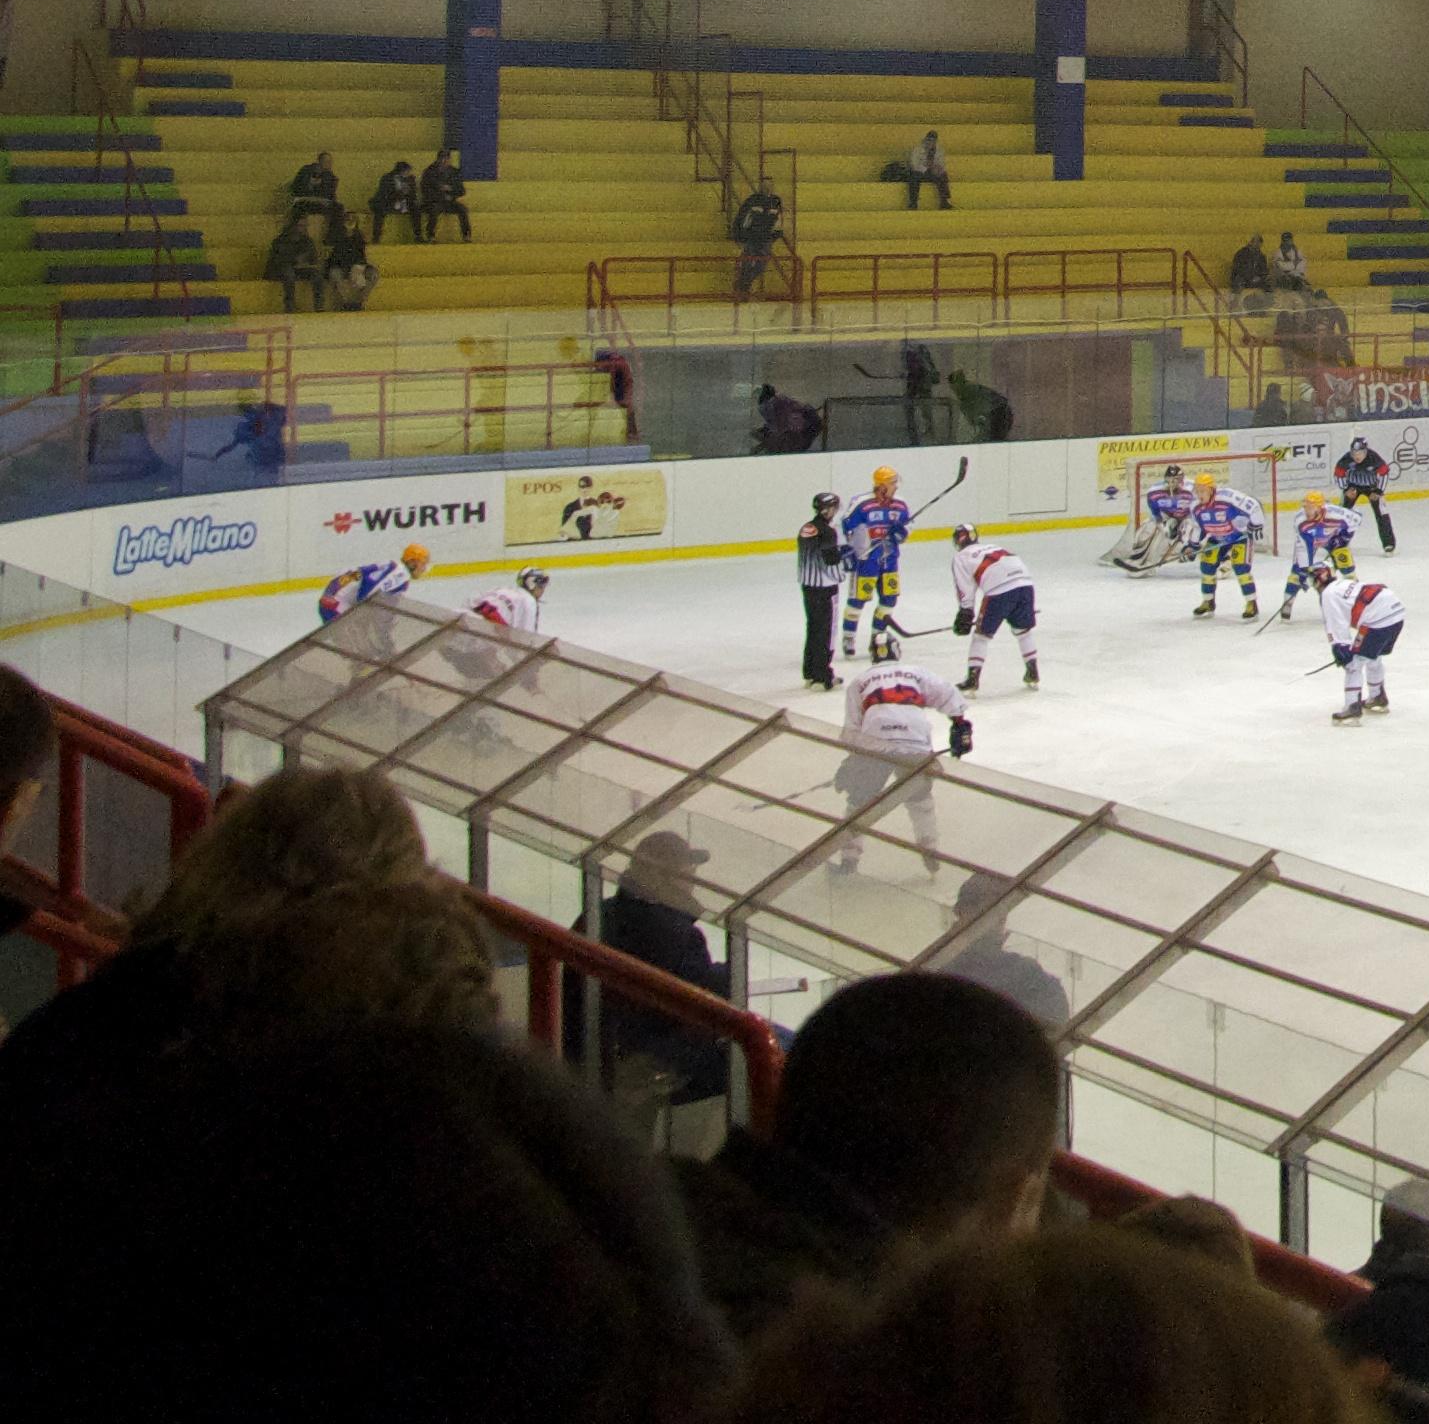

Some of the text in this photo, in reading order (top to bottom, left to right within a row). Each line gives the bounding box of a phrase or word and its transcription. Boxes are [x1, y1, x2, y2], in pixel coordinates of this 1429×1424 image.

[1101, 436, 1220, 454] PRIMALUCE NEWS
[523, 480, 562, 496] EPOS
[364, 501, 486, 532] WÜRTH
